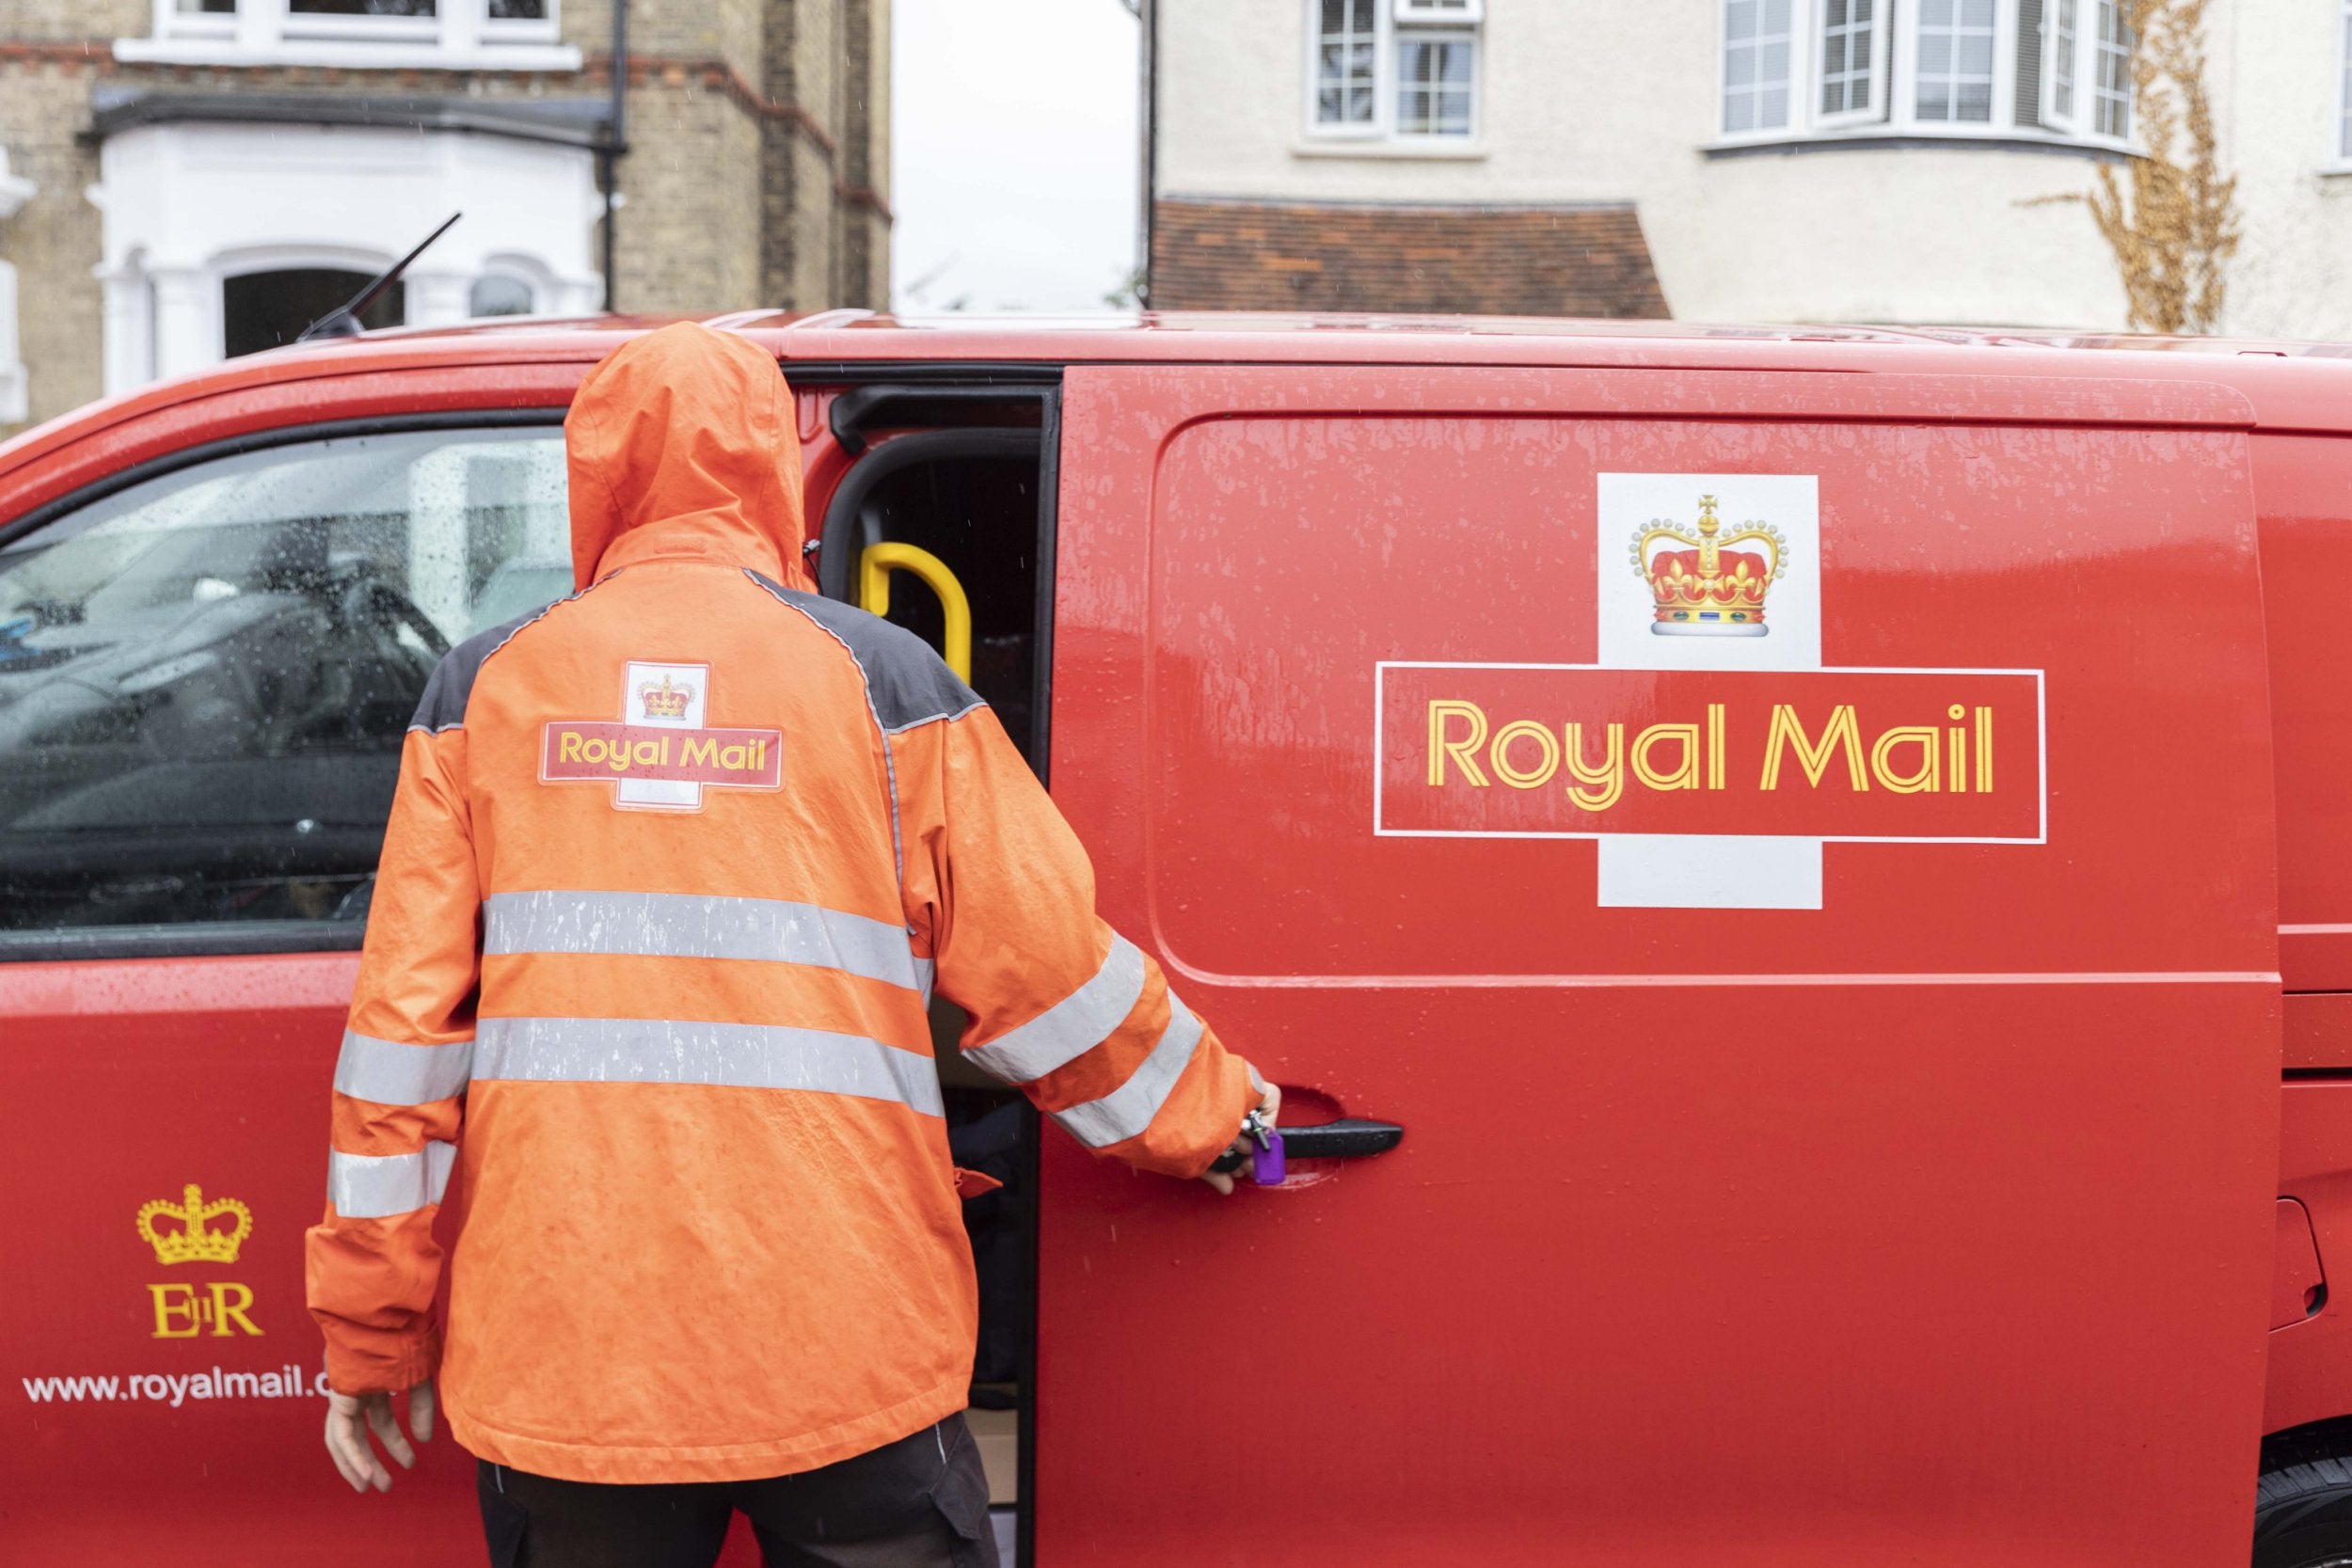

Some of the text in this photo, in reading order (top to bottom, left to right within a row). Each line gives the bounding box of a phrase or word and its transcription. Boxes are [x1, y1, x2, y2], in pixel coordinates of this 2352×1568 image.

[560, 732, 765, 771] Royal Mail
[1427, 700, 1994, 812] Royal Mail
[22, 1365, 330, 1408] www.royalmail.c
